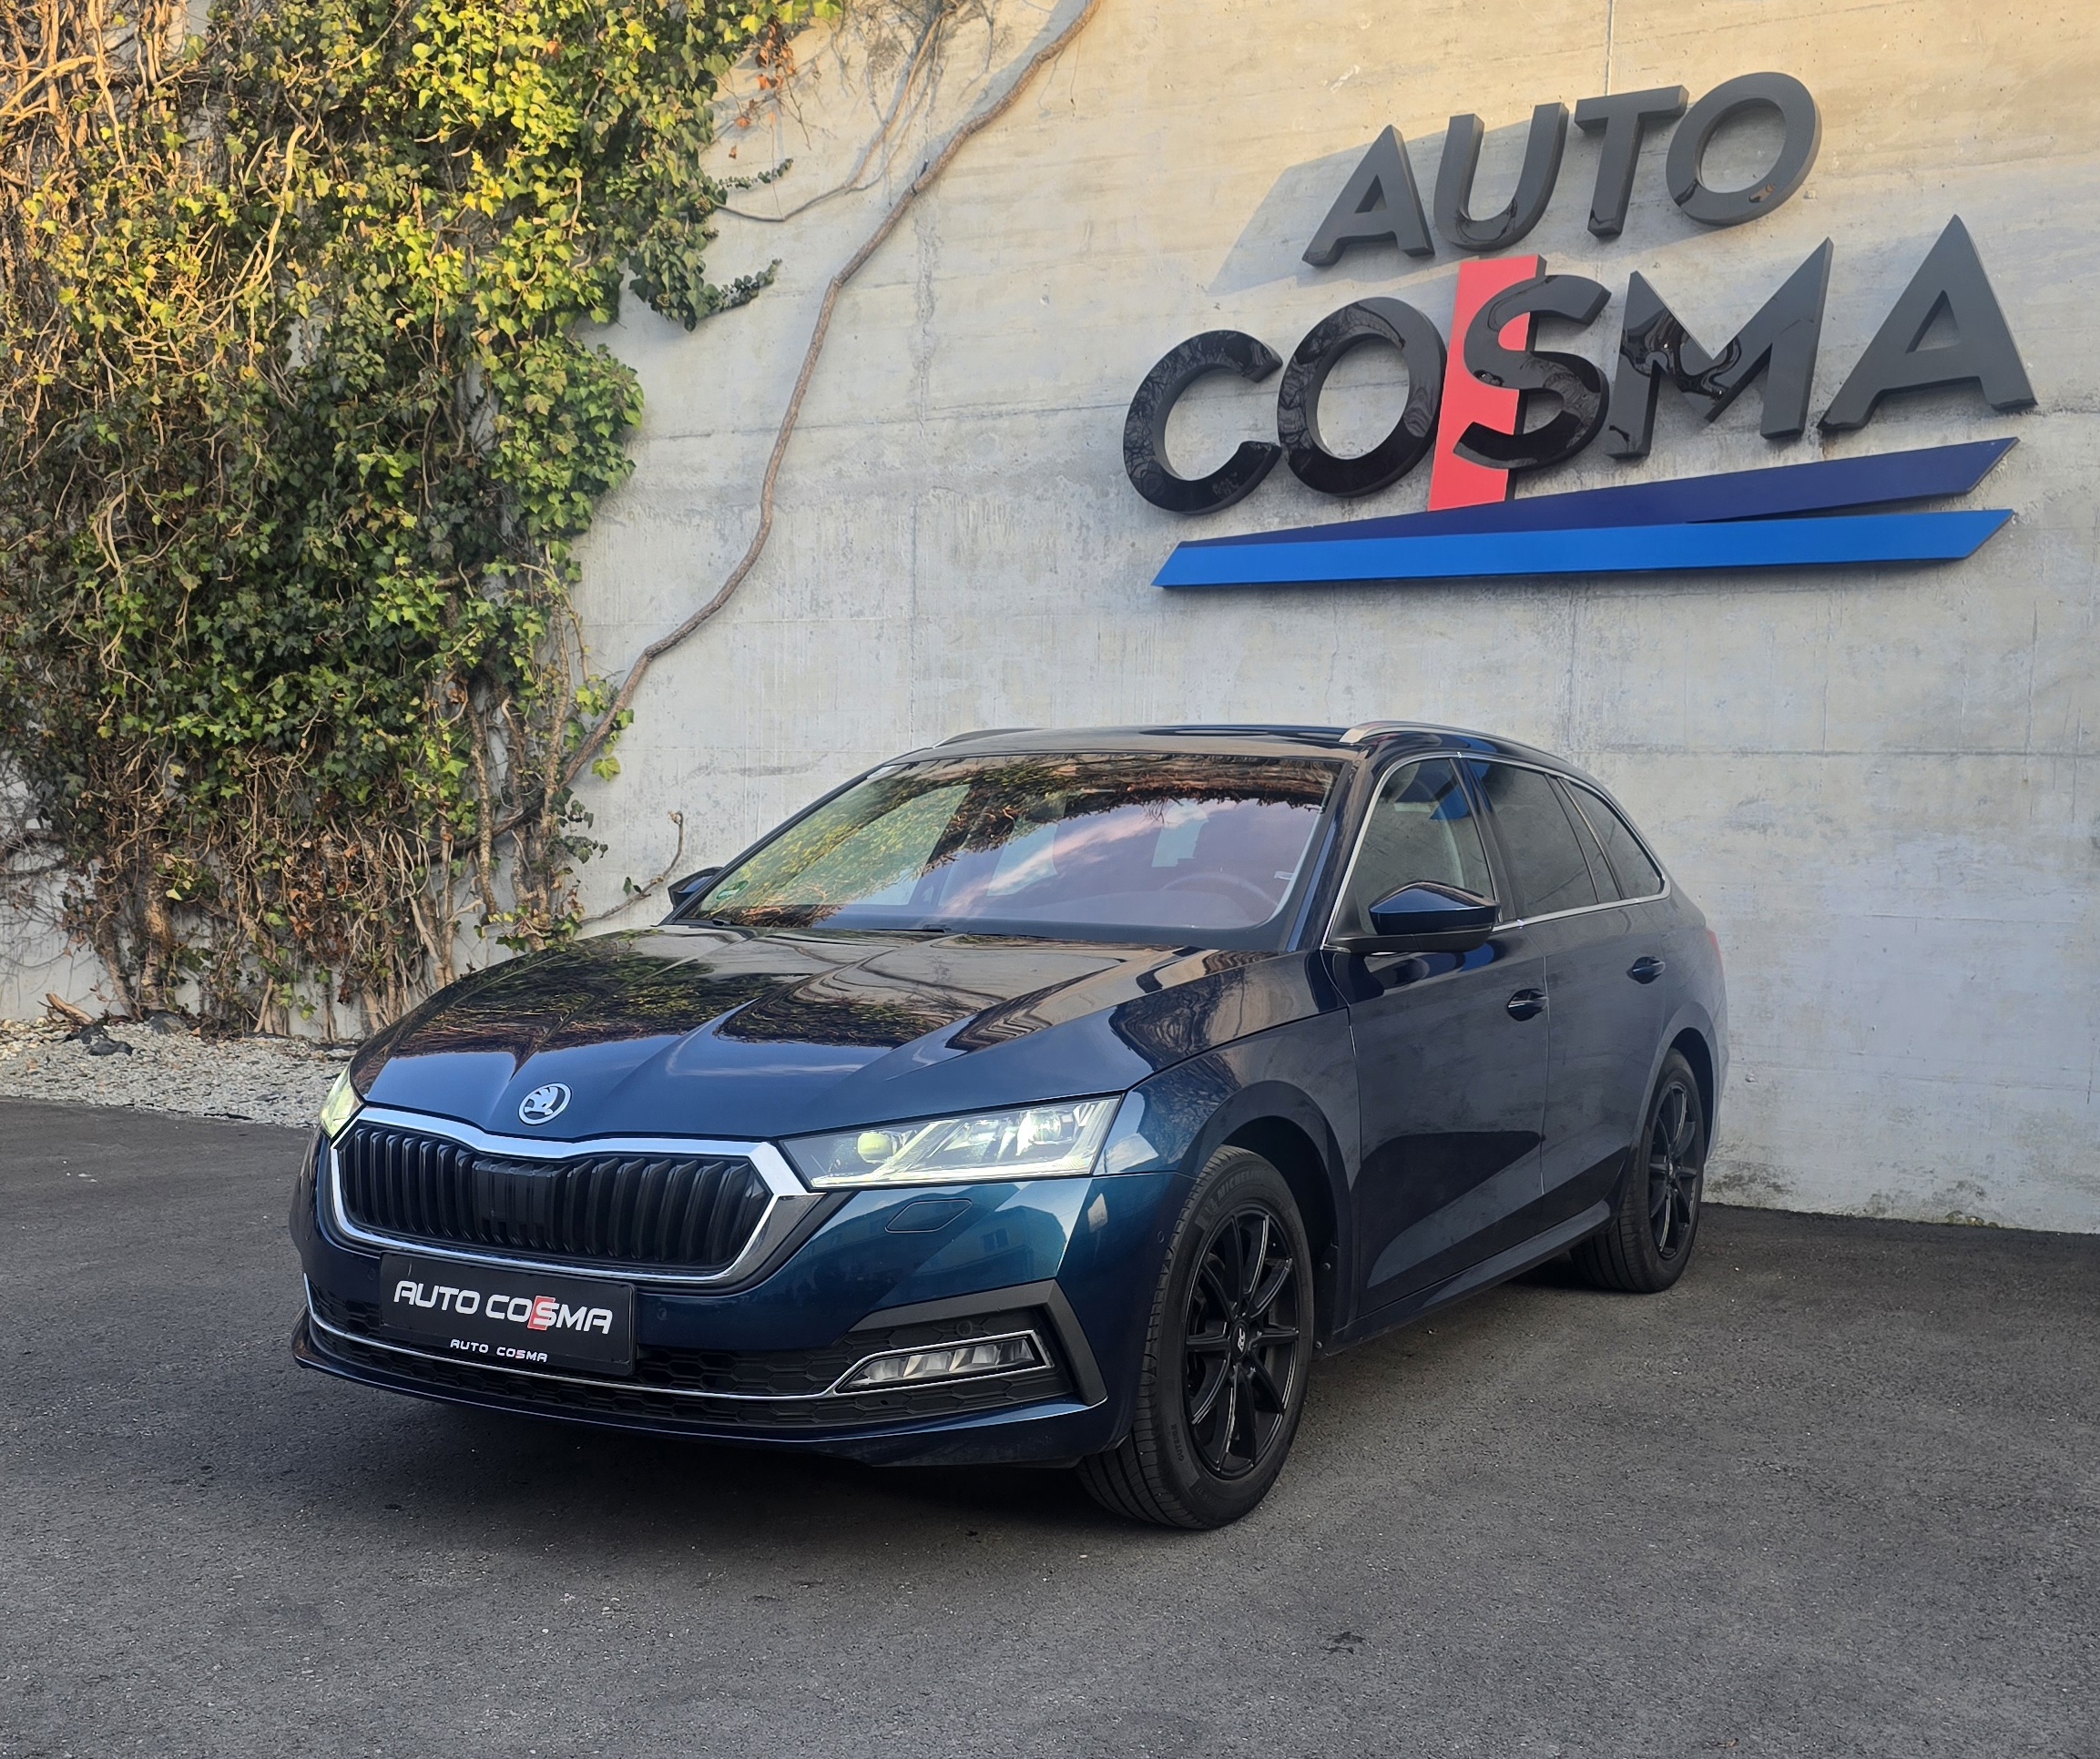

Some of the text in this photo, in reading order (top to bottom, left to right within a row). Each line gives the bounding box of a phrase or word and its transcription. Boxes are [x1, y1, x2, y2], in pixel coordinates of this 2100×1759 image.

[1302, 71, 1822, 268] AUTO
[1122, 214, 2037, 515] COSMA
[393, 1280, 613, 1335] AUTO COSMA
[450, 1338, 548, 1363] AUTO COSMA
